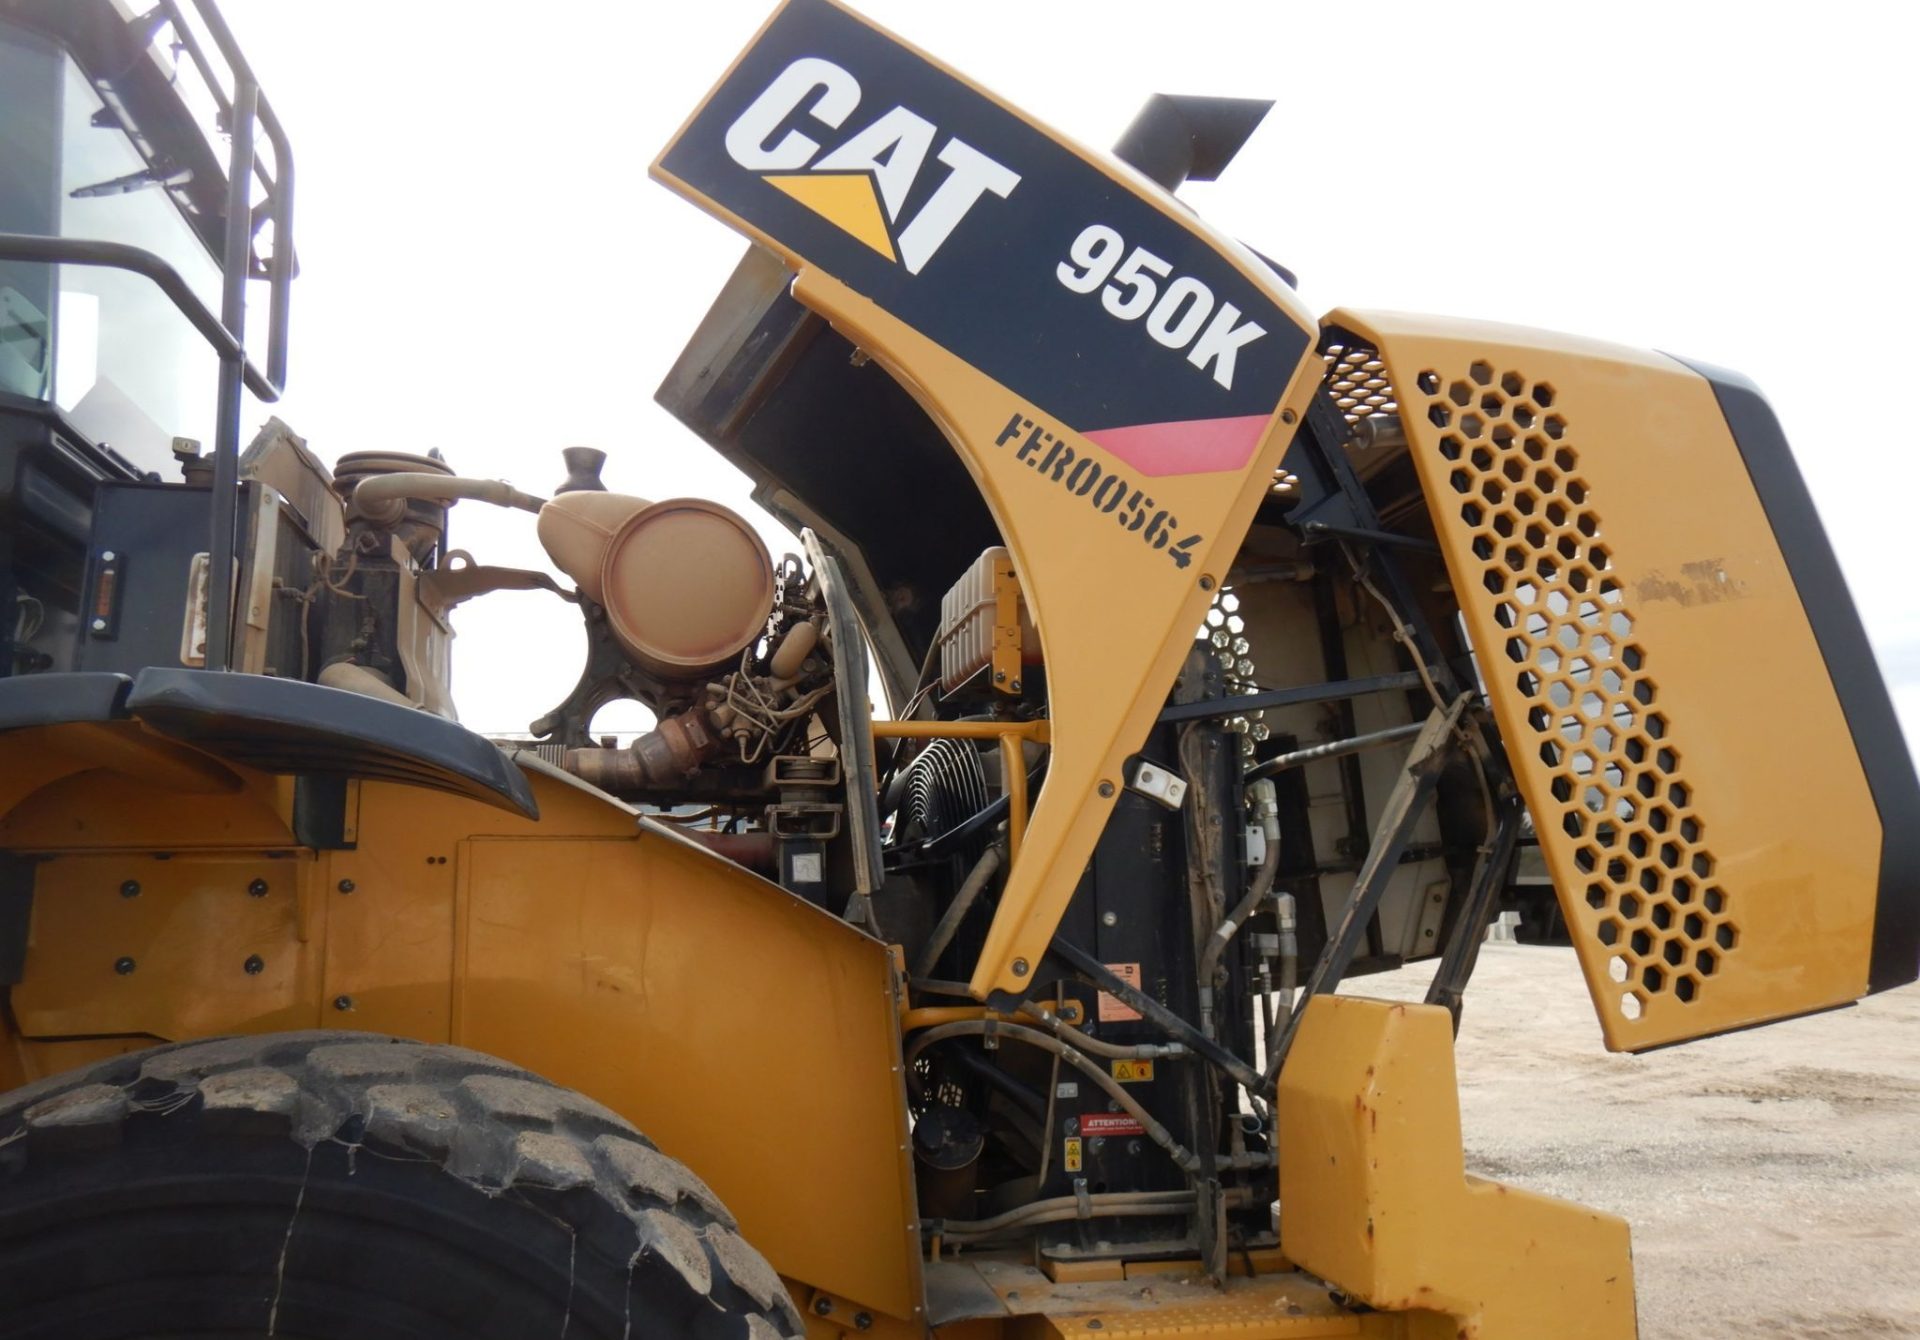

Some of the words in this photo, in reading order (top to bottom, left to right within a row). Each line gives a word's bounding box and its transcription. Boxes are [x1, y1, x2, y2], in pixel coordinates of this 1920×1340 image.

[725, 58, 1021, 275] CAT
[1056, 224, 1267, 391] 950K
[995, 413, 1203, 569] FER00564
